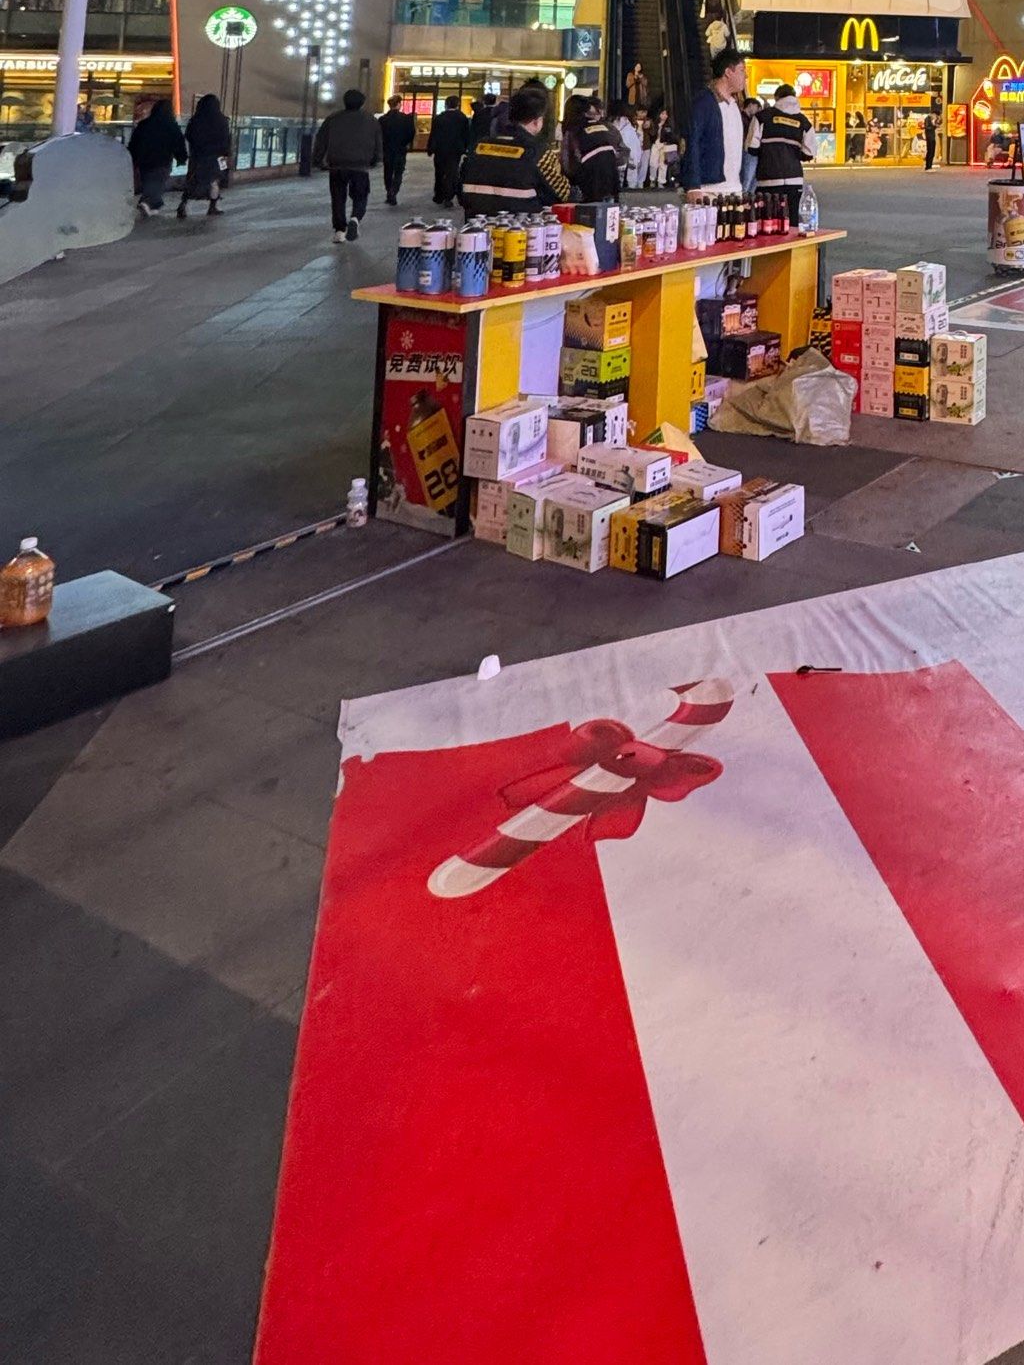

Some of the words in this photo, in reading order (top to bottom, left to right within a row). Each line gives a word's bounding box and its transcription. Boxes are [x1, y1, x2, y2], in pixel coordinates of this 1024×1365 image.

[388, 353, 462, 374] 免费试饮
[424, 458, 459, 501] 28
